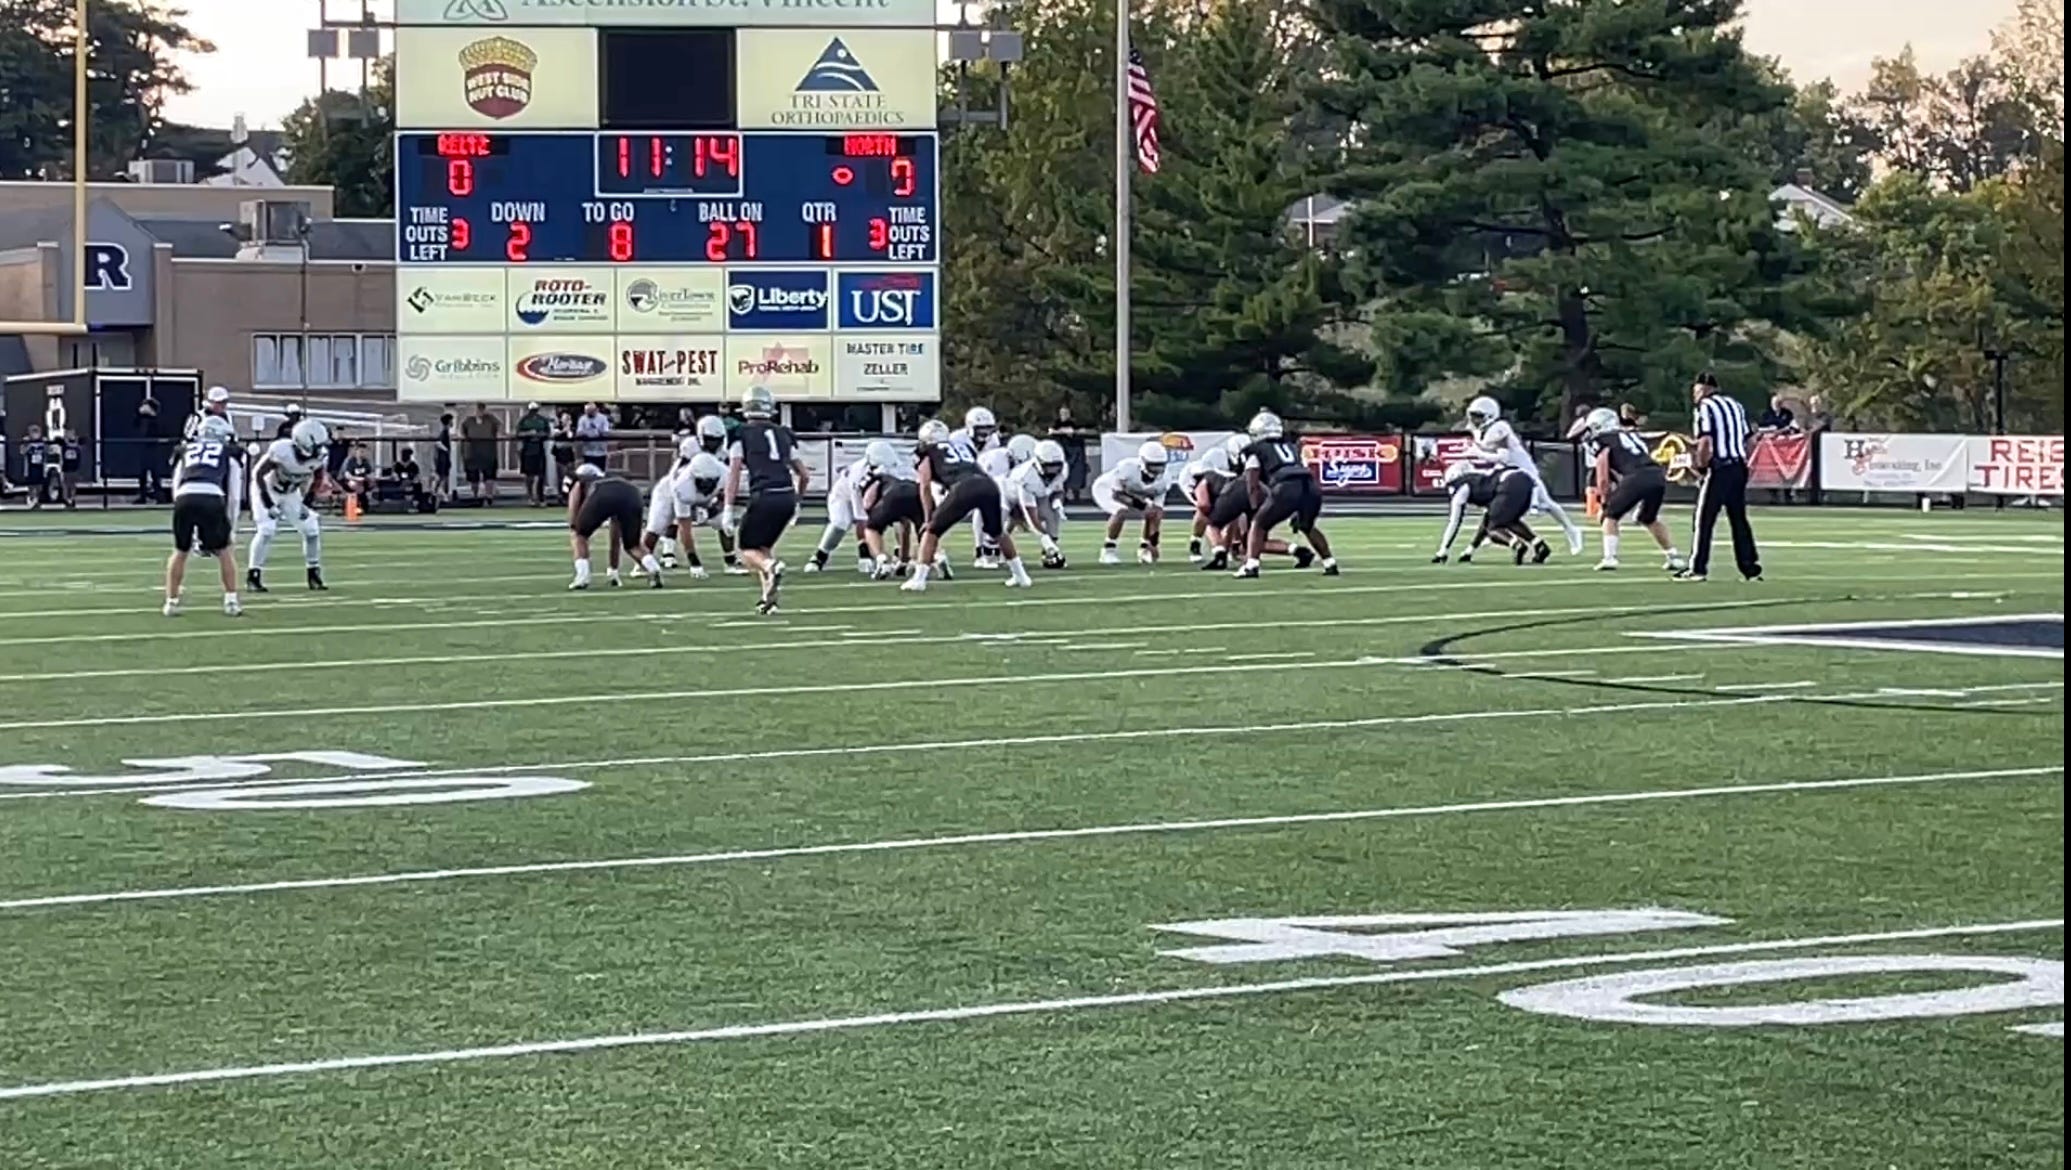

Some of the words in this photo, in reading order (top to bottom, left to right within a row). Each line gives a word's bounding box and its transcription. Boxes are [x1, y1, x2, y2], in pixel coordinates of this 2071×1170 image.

[771, 110, 904, 125] ORTHOPAEDICS
[449, 160, 473, 195] 0
[410, 206, 448, 223] TIME
[491, 202, 546, 222] DOWN
[582, 202, 606, 222] TO
[609, 202, 635, 222] GO
[699, 202, 737, 222] BALL
[740, 202, 763, 222] ON
[802, 202, 837, 222] QTR
[889, 206, 926, 223] TIME
[405, 226, 448, 243] OUTS
[451, 218, 470, 249] 3
[507, 223, 531, 261] 2
[611, 223, 634, 260] 8
[706, 222, 755, 260] 27
[820, 225, 833, 258] 1
[869, 219, 887, 249] 3
[889, 226, 930, 243] OUTS
[410, 245, 448, 260] LEFT
[889, 244, 926, 260] LEFT
[532, 293, 607, 305] ROOTER
[758, 287, 827, 308] Liberty
[738, 360, 819, 375] ProRehab
[864, 363, 908, 375] ZELLER
[185, 442, 224, 467] 22
[763, 430, 780, 460] 1
[1974, 466, 2064, 490] TIRE
